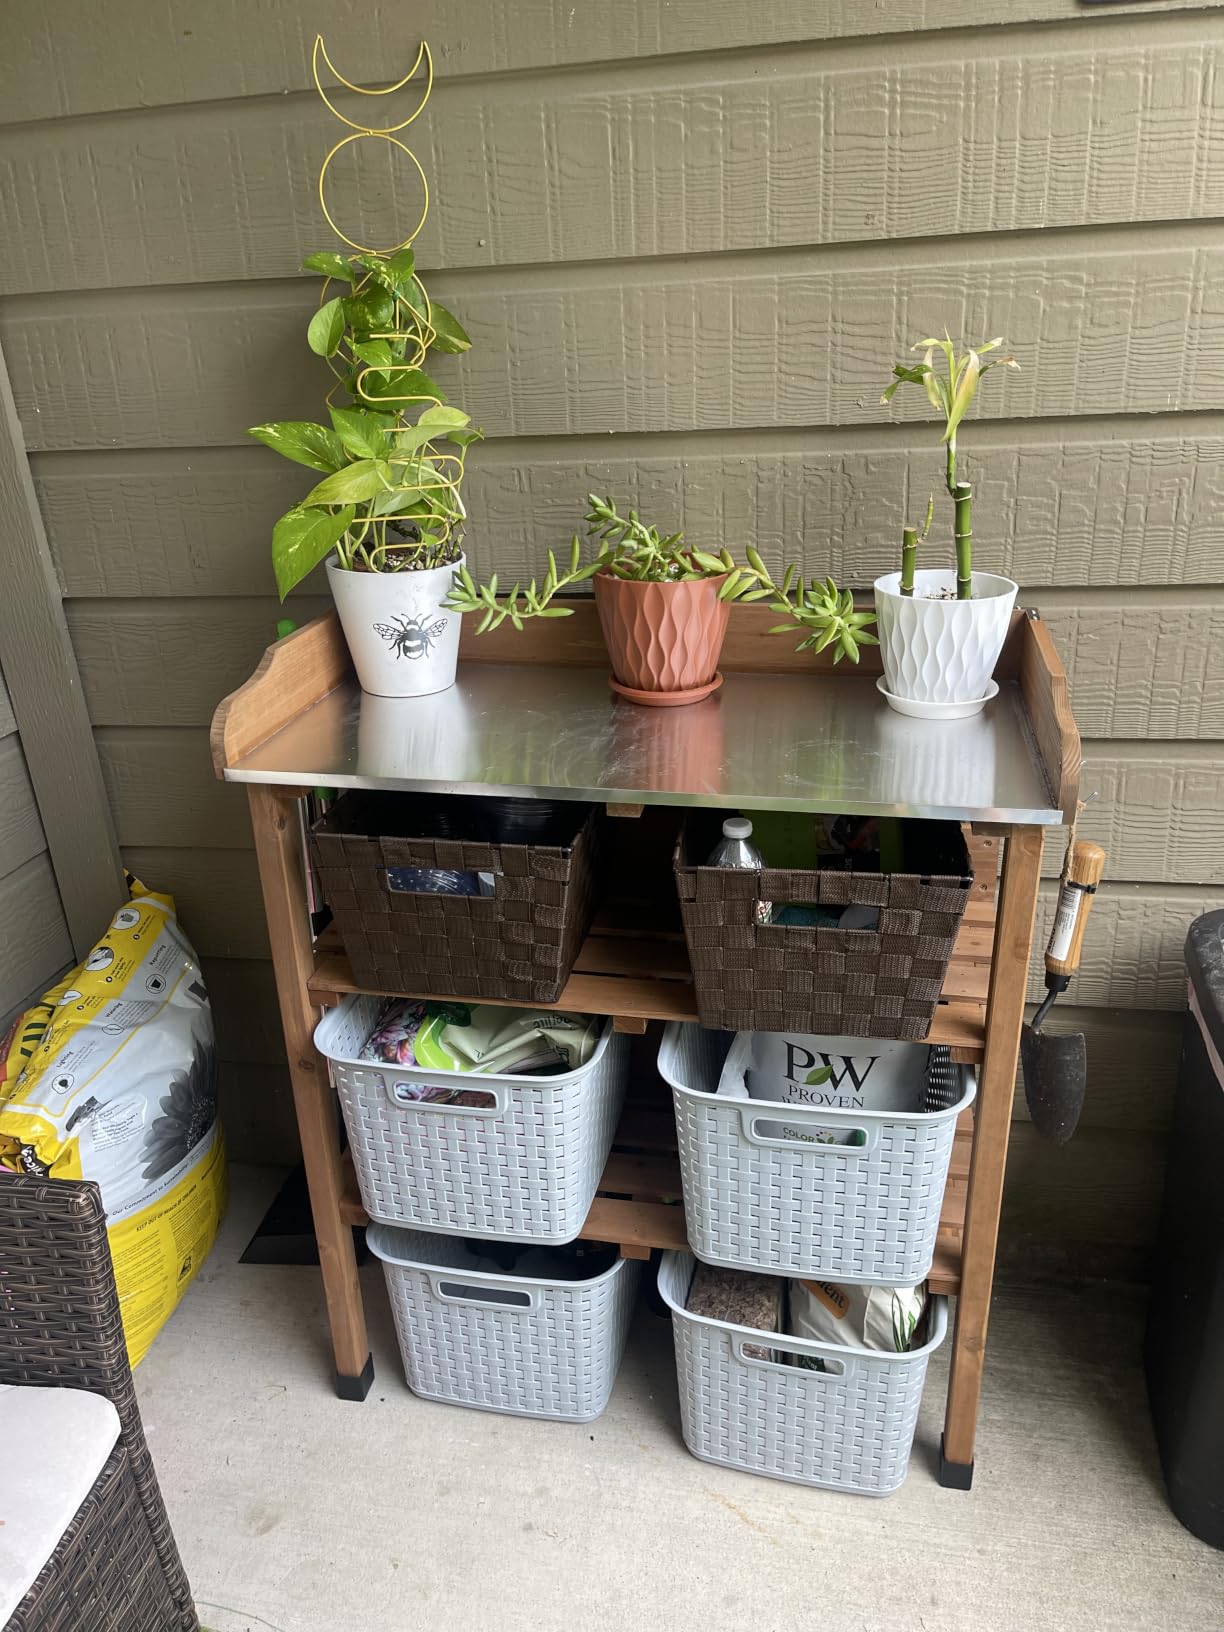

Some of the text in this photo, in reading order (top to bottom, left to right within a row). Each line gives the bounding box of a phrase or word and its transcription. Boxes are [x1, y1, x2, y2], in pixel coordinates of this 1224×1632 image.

[782, 1040, 882, 1093] PW
[788, 1084, 865, 1109] PROVEN
[783, 1126, 815, 1143] COLOR
